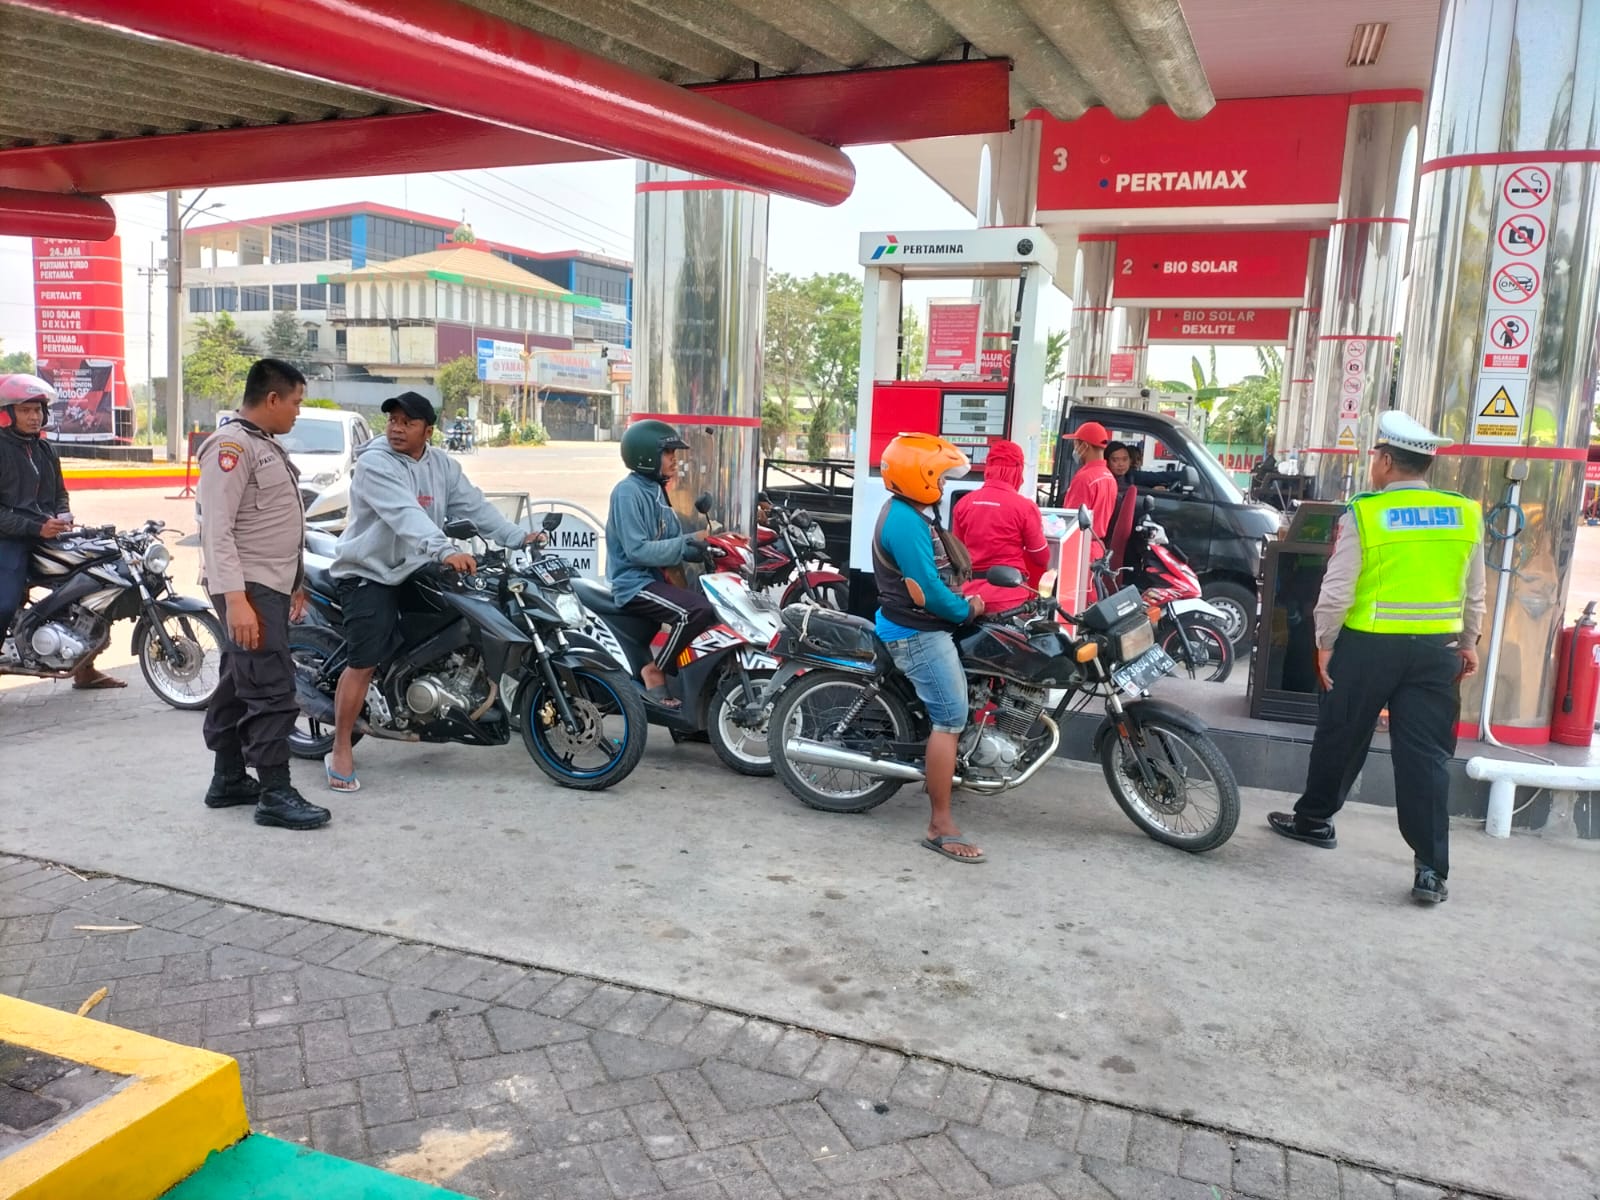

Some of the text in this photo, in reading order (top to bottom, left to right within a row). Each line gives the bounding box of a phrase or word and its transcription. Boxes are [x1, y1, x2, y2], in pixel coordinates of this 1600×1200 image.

[1052, 148, 1068, 171] 3
[1115, 170, 1248, 192] PERTAMAX
[903, 244, 964, 254] PERTAMINA
[1121, 259, 1133, 275] 2
[1163, 260, 1239, 273] BIO SOLAR
[40, 270, 74, 279] PERTAMAX
[40, 291, 82, 300] PERTALITE
[42, 310, 81, 319] BIO SOLAR
[1156, 310, 1162, 321] 1
[1183, 311, 1255, 321] BIO SOLAR
[42, 320, 82, 329] DEXLITE
[1182, 324, 1236, 335] DEXLITE
[42, 335, 76, 343] PELUMAS
[42, 344, 84, 353] PERTAMINA
[981, 353, 1003, 361] ALUR
[1388, 507, 1456, 526] POLISI
[562, 531, 596, 547] MAAF
